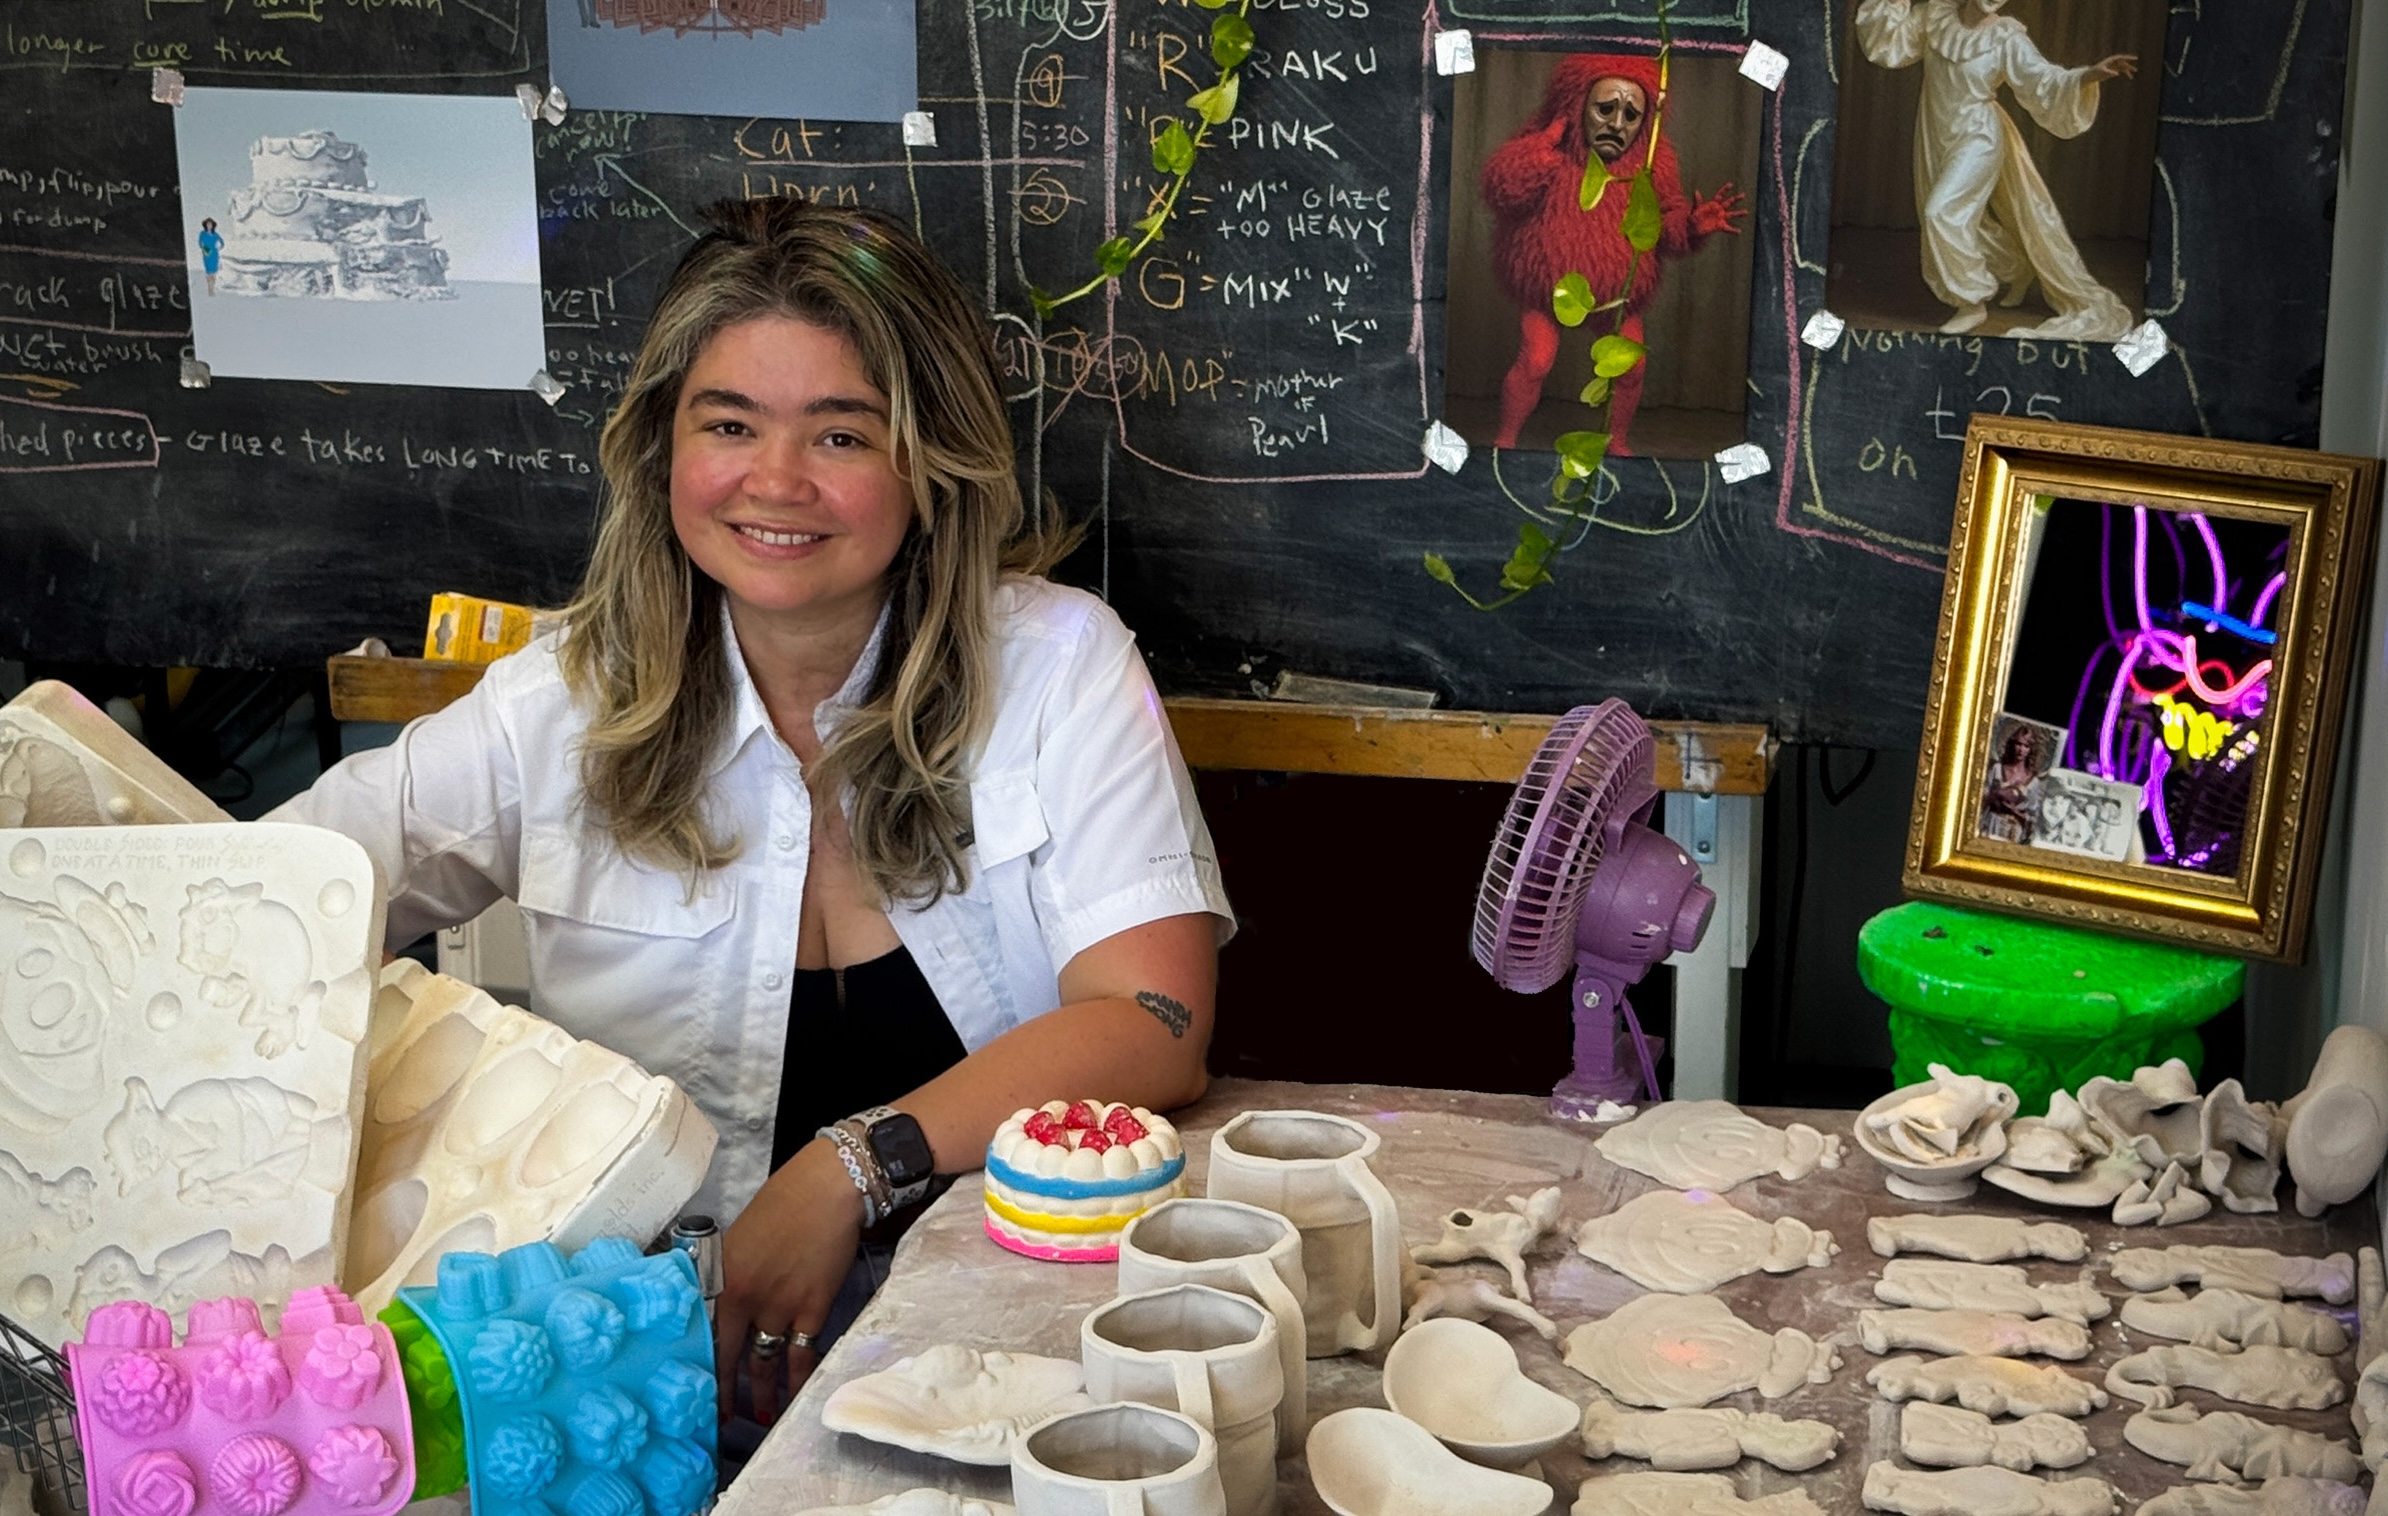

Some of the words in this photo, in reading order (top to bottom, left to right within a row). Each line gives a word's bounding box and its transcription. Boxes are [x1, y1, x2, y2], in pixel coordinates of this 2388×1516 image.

[8, 23, 105, 74] longer
[133, 40, 193, 60] cure
[214, 36, 292, 66] time
[1248, 46, 1377, 82] RAKU
[1022, 120, 1090, 152] 5:30
[1228, 117, 1340, 160] PINK
[549, 179, 612, 204] come
[611, 199, 662, 220] later
[1287, 213, 1387, 246] HEAVY
[300, 428, 386, 466] takes
[1246, 414, 1330, 457] Pearl
[55, 837, 113, 852] DOUBLE
[176, 854, 221, 870] THIN
[631, 1171, 665, 1195] inc.
